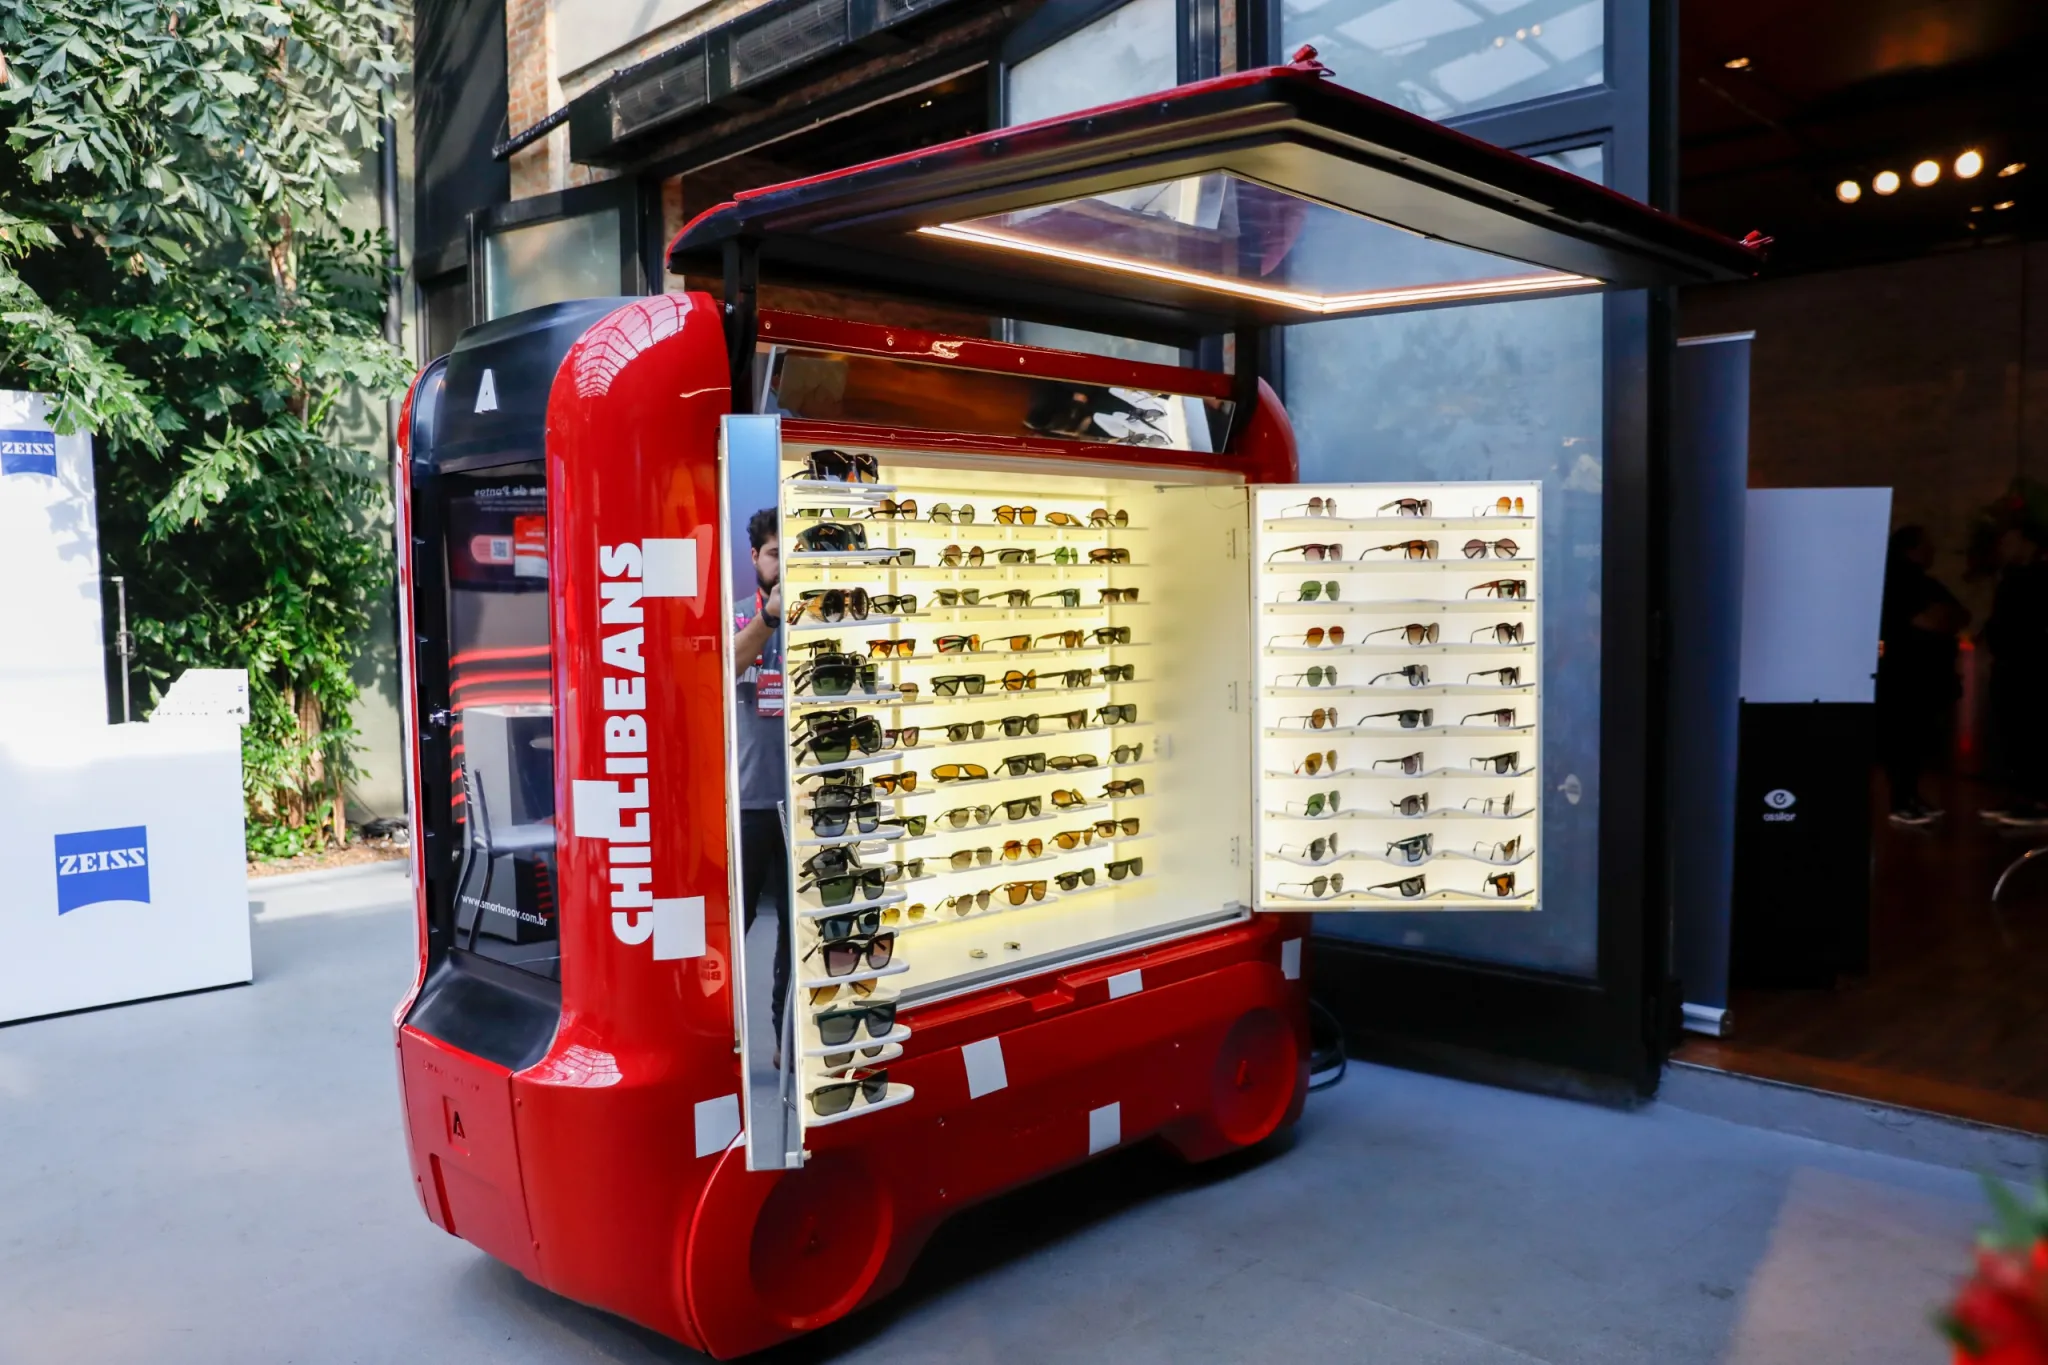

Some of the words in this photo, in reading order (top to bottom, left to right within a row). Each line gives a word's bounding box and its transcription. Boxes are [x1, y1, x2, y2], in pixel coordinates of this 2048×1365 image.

[2, 441, 54, 456] ZEISS
[59, 847, 146, 876] ZEISS
[461, 894, 548, 927] www.smartmoov.com.br
